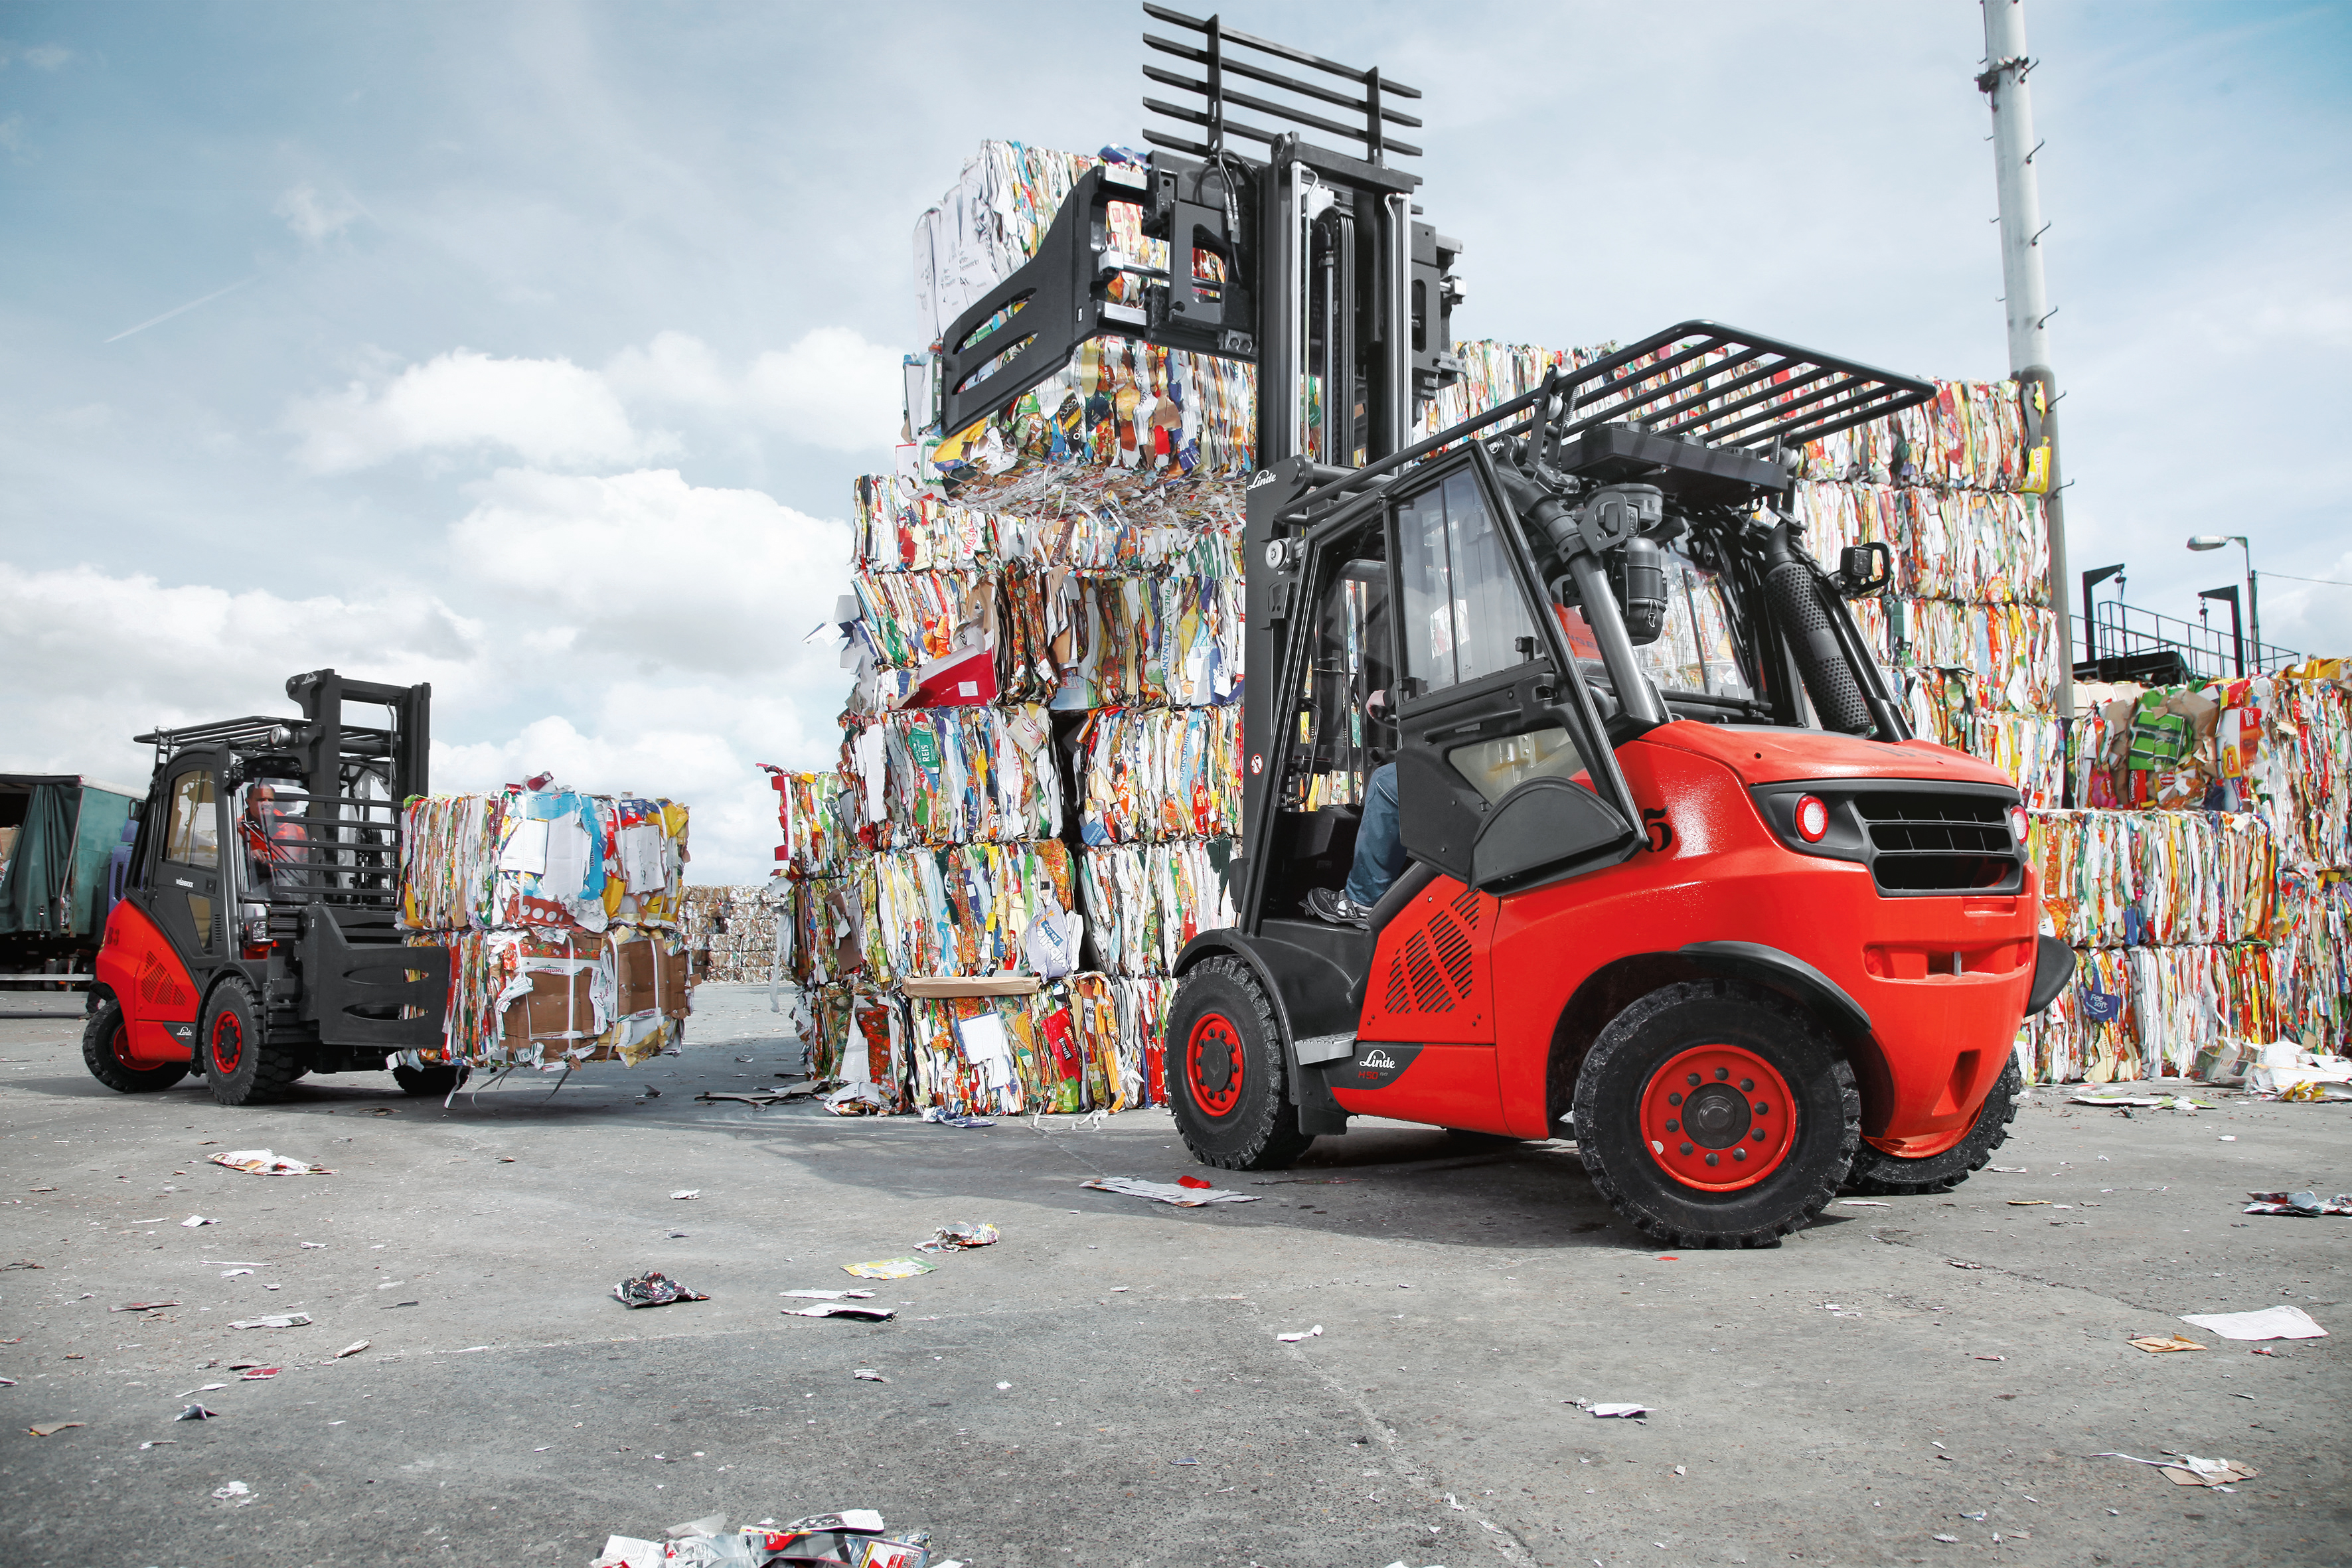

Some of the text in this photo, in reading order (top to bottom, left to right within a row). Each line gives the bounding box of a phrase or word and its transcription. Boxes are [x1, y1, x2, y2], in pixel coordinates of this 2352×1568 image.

[1247, 470, 1276, 490] Linde
[921, 744, 930, 762] REIS
[1044, 923, 1061, 943] Junior
[1036, 926, 1066, 968] vibelle
[2090, 994, 2104, 1002] Fee
[177, 1026, 192, 1036] Linde
[1359, 1050, 1395, 1069] Linde
[1358, 1071, 1379, 1080] H50
